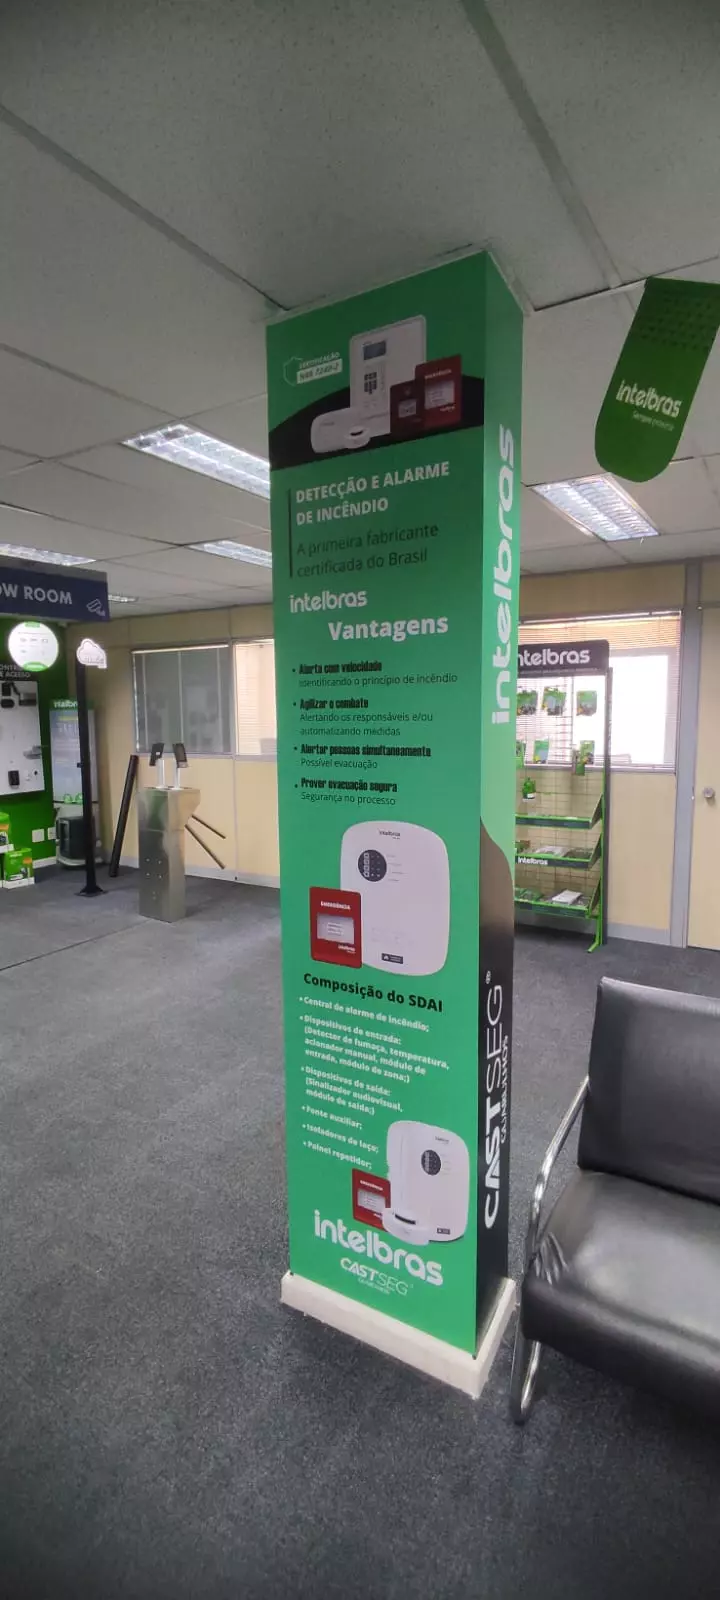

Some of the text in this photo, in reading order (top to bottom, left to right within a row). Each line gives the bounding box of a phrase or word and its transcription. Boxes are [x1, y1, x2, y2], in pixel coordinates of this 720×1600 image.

[616, 379, 683, 418] intelbras
[296, 461, 450, 503] DETECÇÃO E ALARME
[296, 497, 389, 526] DE INCÊNDIO
[297, 524, 439, 557] A primeira fabricante
[297, 547, 428, 578] certificada do Brasil
[492, 424, 515, 724] intelbras
[24, 586, 72, 605] ROOM
[289, 590, 368, 613] intelbras
[328, 616, 449, 642] Vantagens
[518, 648, 591, 666] ntelbras
[299, 660, 383, 675] Alerta com velocidade
[353, 677, 360, 686] o
[362, 674, 400, 688] princípio
[402, 674, 415, 684] de
[416, 672, 458, 684] incêndio
[329, 701, 334, 710] o
[300, 711, 433, 724] Alertando os responsáveis e/ou
[300, 727, 400, 737] automatizando medidas
[301, 758, 378, 771] Possível evacuação
[301, 777, 398, 794] Prover evacuação segura
[301, 791, 396, 806] Segurança no processo
[304, 973, 443, 1012] Composição do SDAI
[304, 996, 333, 1009] Central
[333, 1003, 344, 1013] de
[345, 1006, 375, 1020] alarme
[376, 1012, 387, 1022] de
[304, 1014, 352, 1033] Dispositivos
[353, 1026, 363, 1036] de
[342, 1036, 353, 1045] de
[339, 1056, 370, 1071] módulo
[371, 1065, 382, 1075] de
[380, 1057, 413, 1072] módulo
[414, 1065, 426, 1075] de
[305, 1066, 353, 1086] Dispositivos
[354, 1079, 364, 1089] de
[336, 1097, 346, 1106] de
[306, 1105, 328, 1118] Fonte
[307, 1140, 331, 1155] Painel
[347, 1136, 358, 1146] de
[314, 1209, 444, 1286] intelbras
